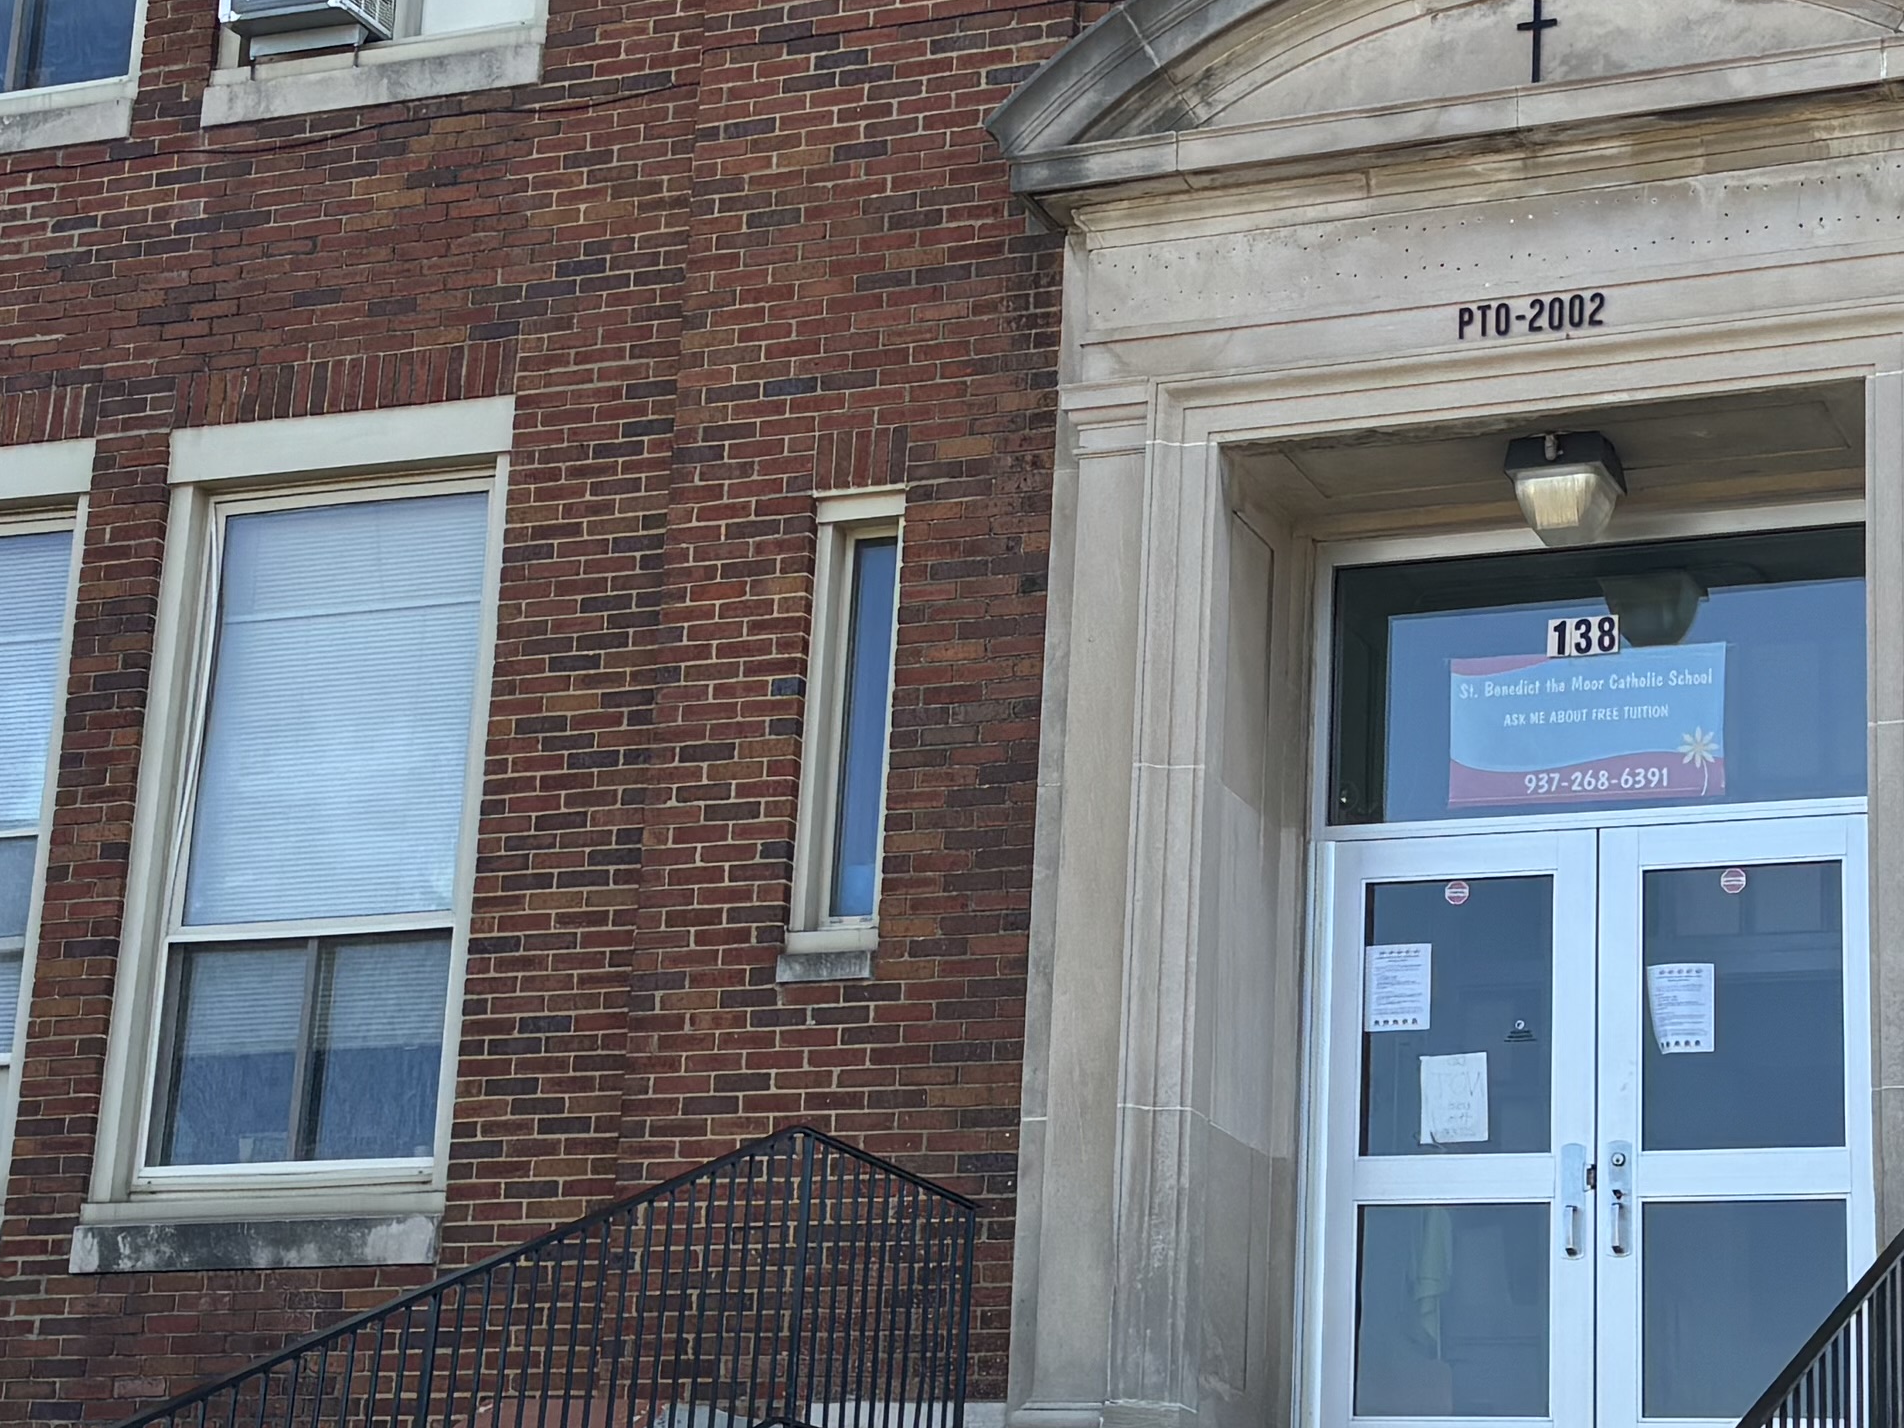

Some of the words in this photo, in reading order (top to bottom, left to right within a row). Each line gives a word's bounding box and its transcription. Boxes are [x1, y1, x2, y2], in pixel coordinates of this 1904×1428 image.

[1458, 292, 1605, 340] PTO-2002
[1553, 616, 1616, 656] 138
[1459, 683, 1478, 699] St.
[1485, 679, 1540, 697] Benedict
[1546, 678, 1565, 692] the
[1571, 675, 1604, 692] Moor
[1609, 672, 1664, 690] Catholic
[1668, 668, 1713, 686] School
[1504, 713, 1526, 727] ASK
[1530, 711, 1545, 725] ME
[1549, 709, 1588, 724] ABOUT
[1592, 707, 1619, 721] FREE
[1623, 704, 1669, 721] TUITION
[1524, 767, 1669, 794] 937-268-6391
